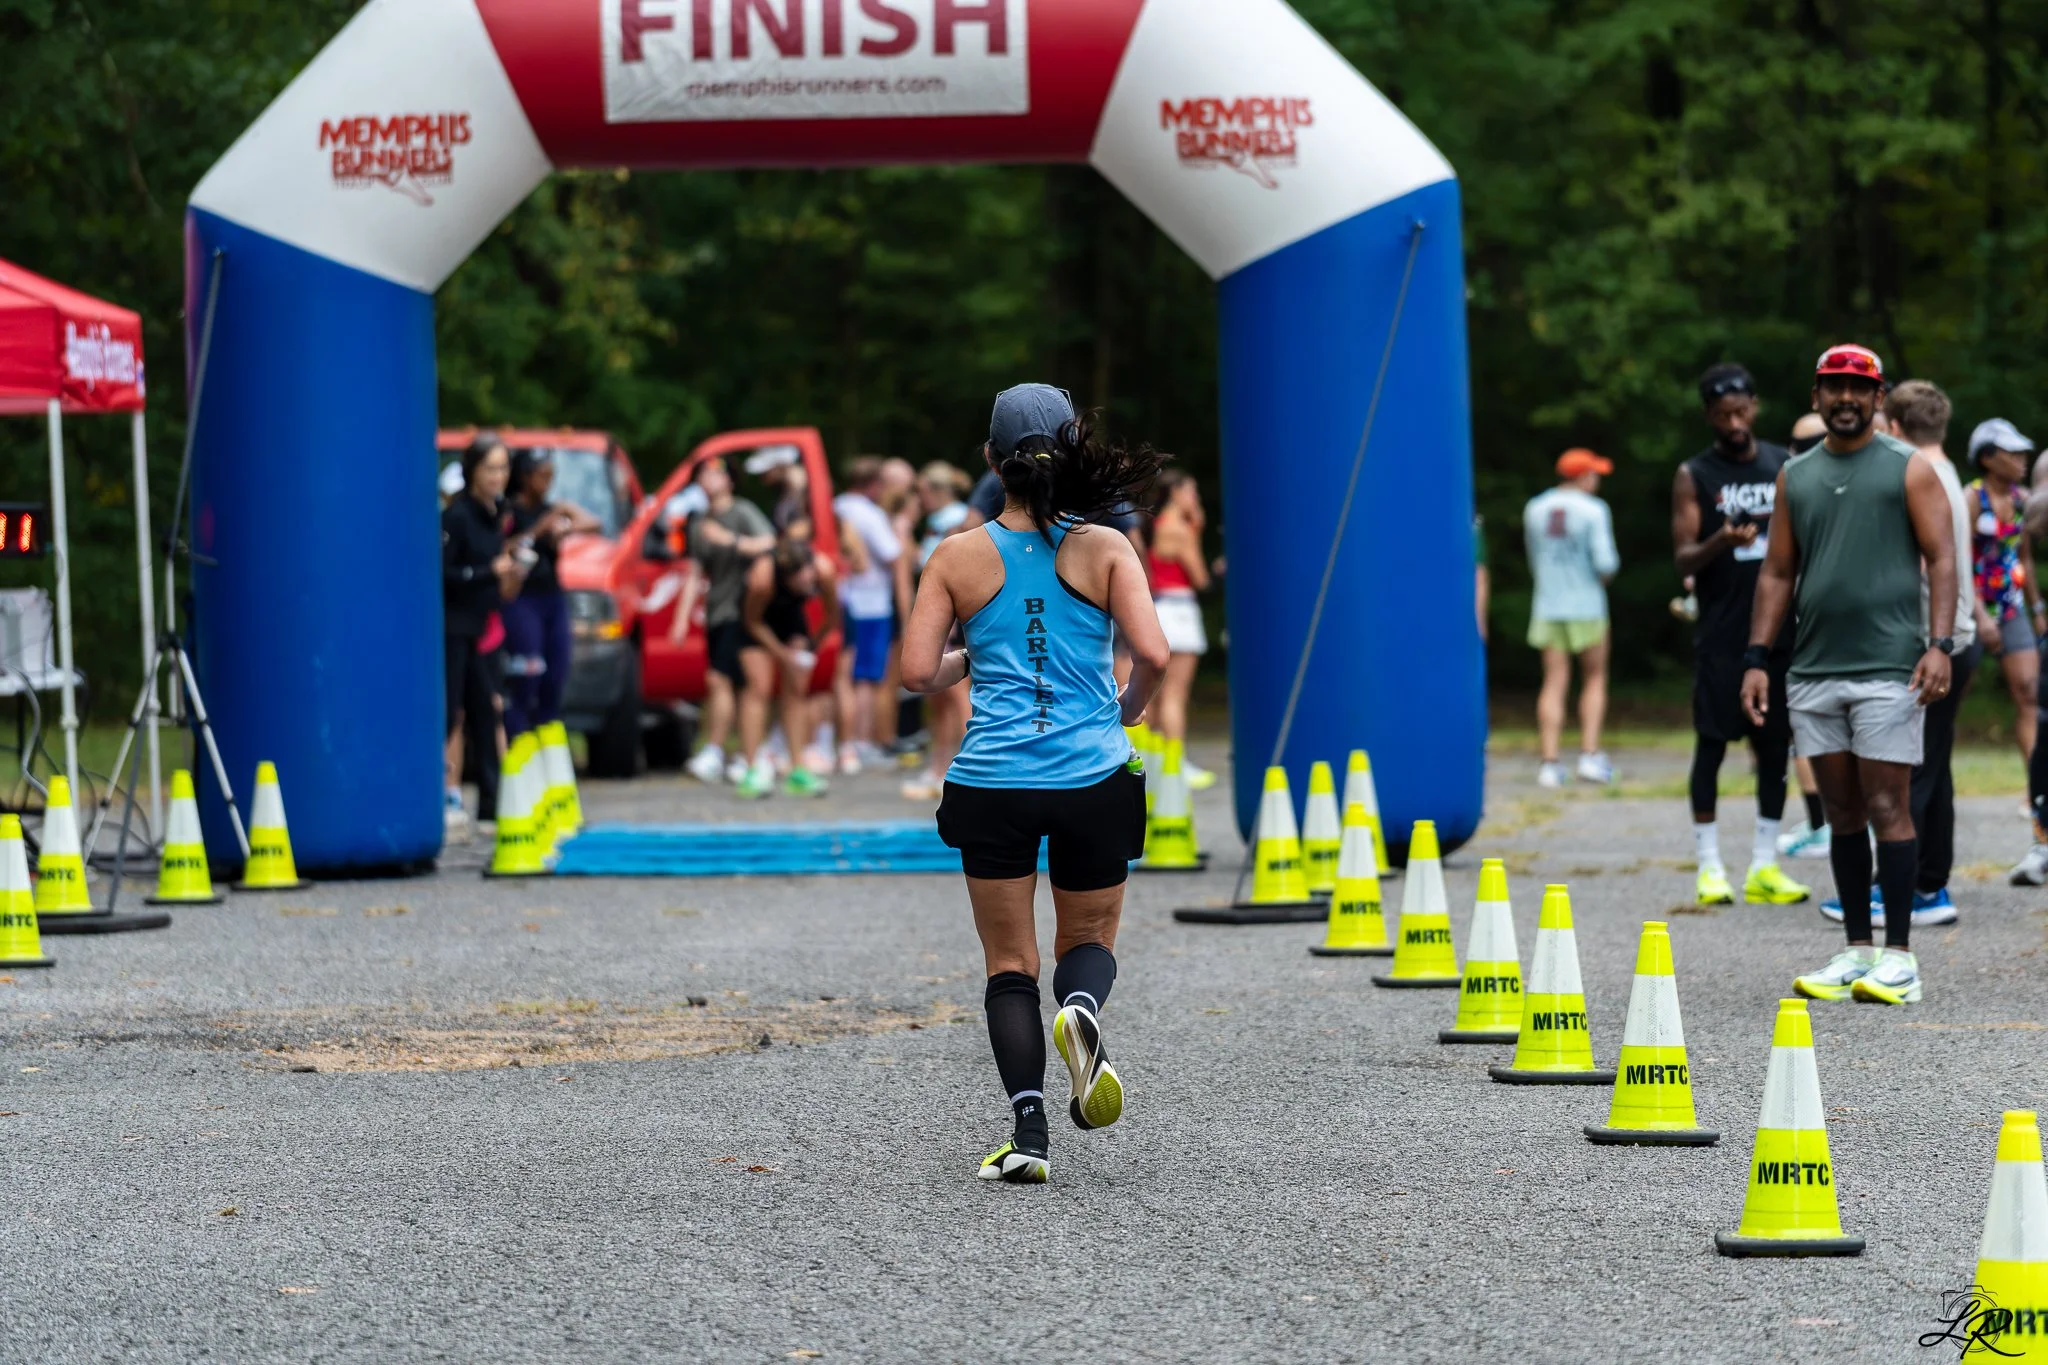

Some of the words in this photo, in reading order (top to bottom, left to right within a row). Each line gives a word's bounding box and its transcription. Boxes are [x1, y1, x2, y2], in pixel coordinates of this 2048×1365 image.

[620, 0, 1010, 64] FINISH
[685, 75, 947, 99] memphisrunners.com
[1160, 96, 1314, 130] MEMPHIS
[318, 112, 472, 150] MEMPHIS
[1023, 597, 1054, 734] BARTLETT
[1339, 900, 1381, 915] MRTC
[0, 912, 33, 928] RTC
[1406, 928, 1452, 945] MRTC
[1466, 976, 1519, 994] MRTC
[1533, 1011, 1588, 1031] MRTC
[1626, 1064, 1688, 1085] MRTC
[1757, 1161, 1829, 1185] MRTC
